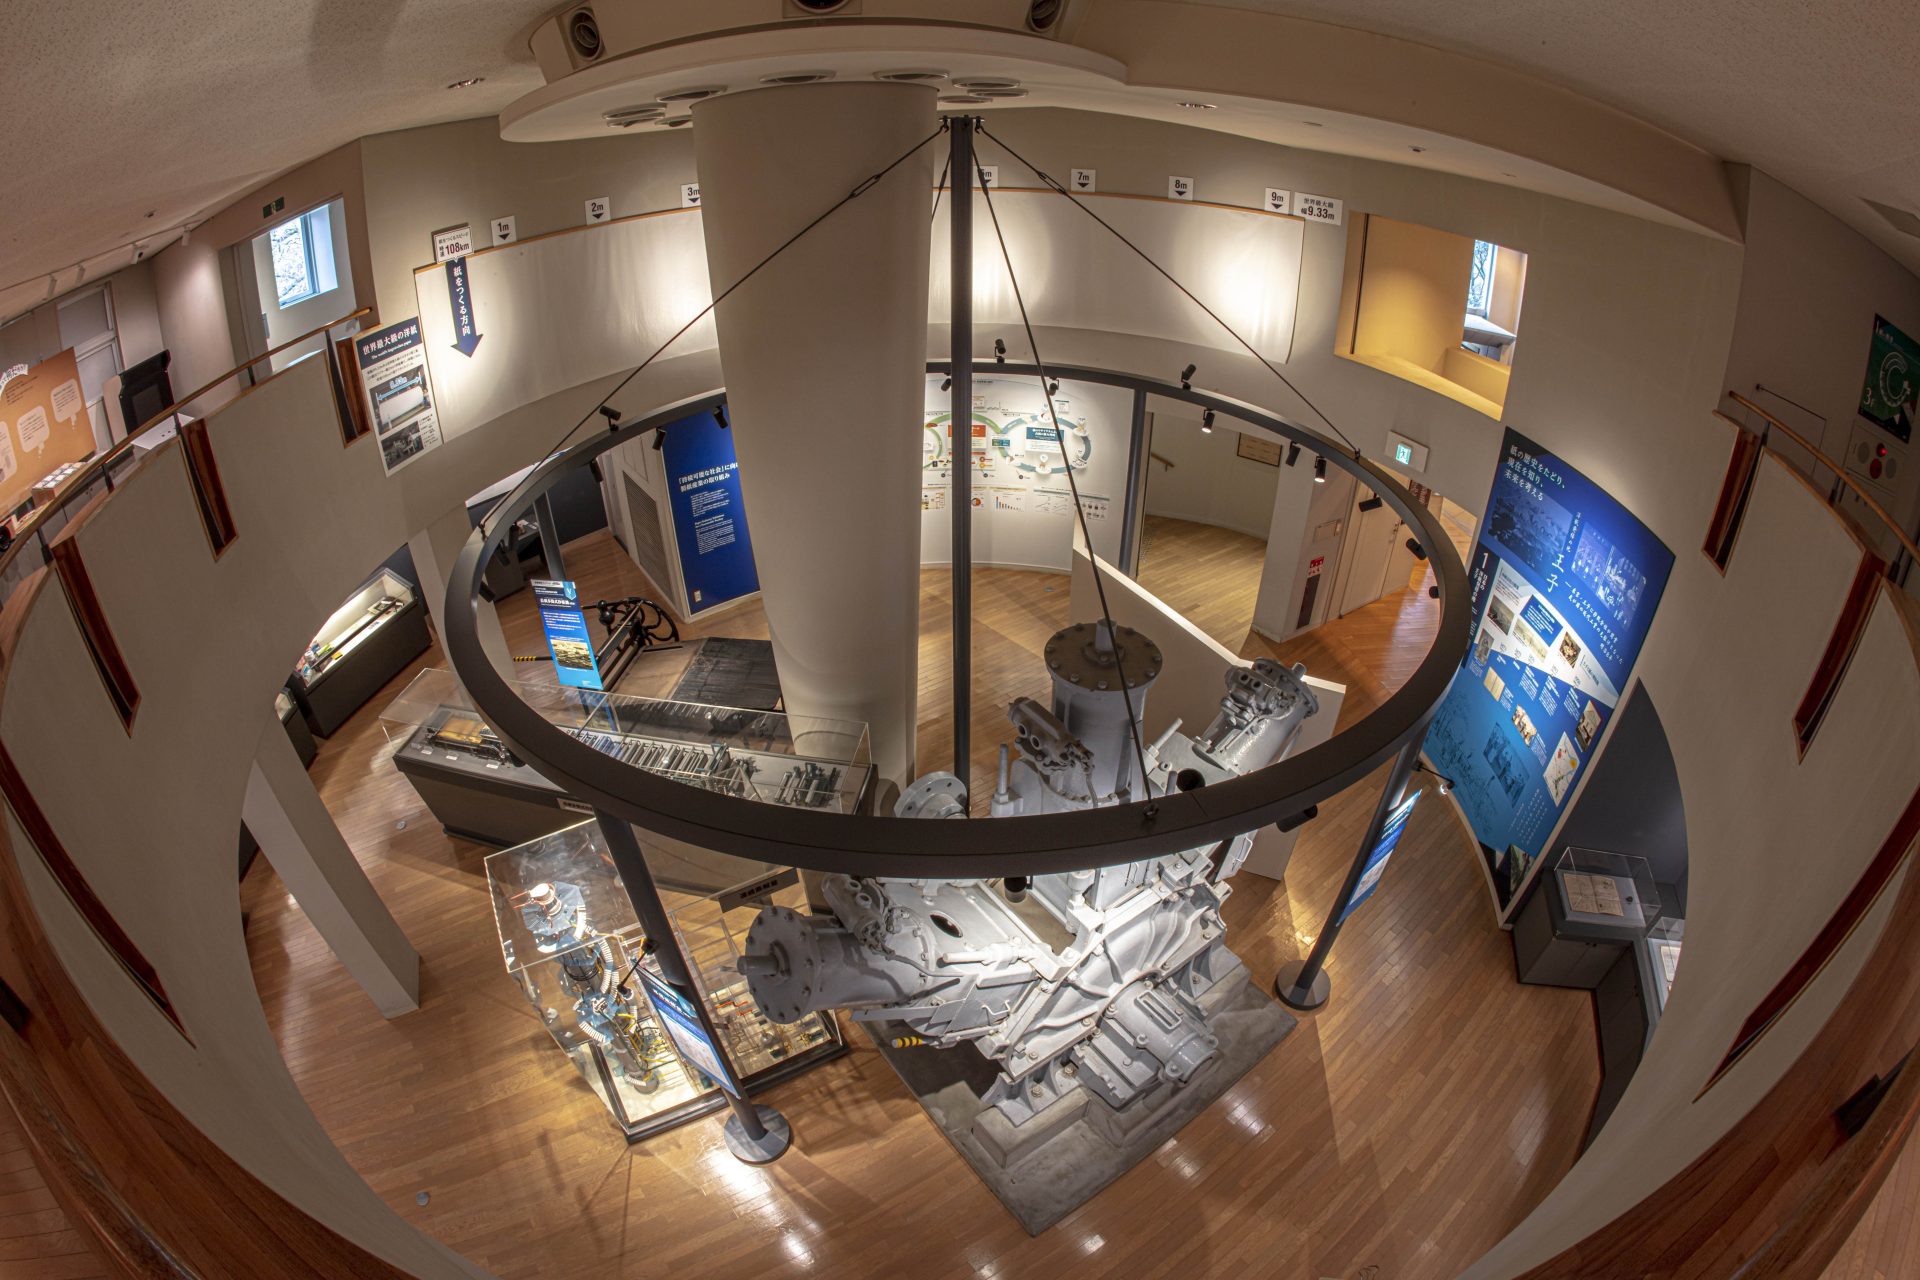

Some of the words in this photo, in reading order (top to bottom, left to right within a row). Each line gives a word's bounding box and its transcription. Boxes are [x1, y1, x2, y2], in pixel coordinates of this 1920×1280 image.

[1078, 172, 1090, 181] 7m
[688, 187, 700, 196] 3m
[1174, 180, 1187, 189] 8m
[1271, 192, 1284, 202] 9m
[591, 202, 603, 212] 2m
[498, 222, 510, 232] 1m
[445, 242, 469, 256] 108km
[454, 266, 470, 336] 紙をつくる方向
[362, 325, 418, 355] 世界最大級の洋紙
[1508, 456, 1543, 488] 現在を知り、
[1510, 445, 1565, 488] 紙の歴史をたどり、
[1504, 469, 1543, 501] 未来を考える
[1482, 552, 1488, 569] 1
[1546, 554, 1565, 592] 王子
